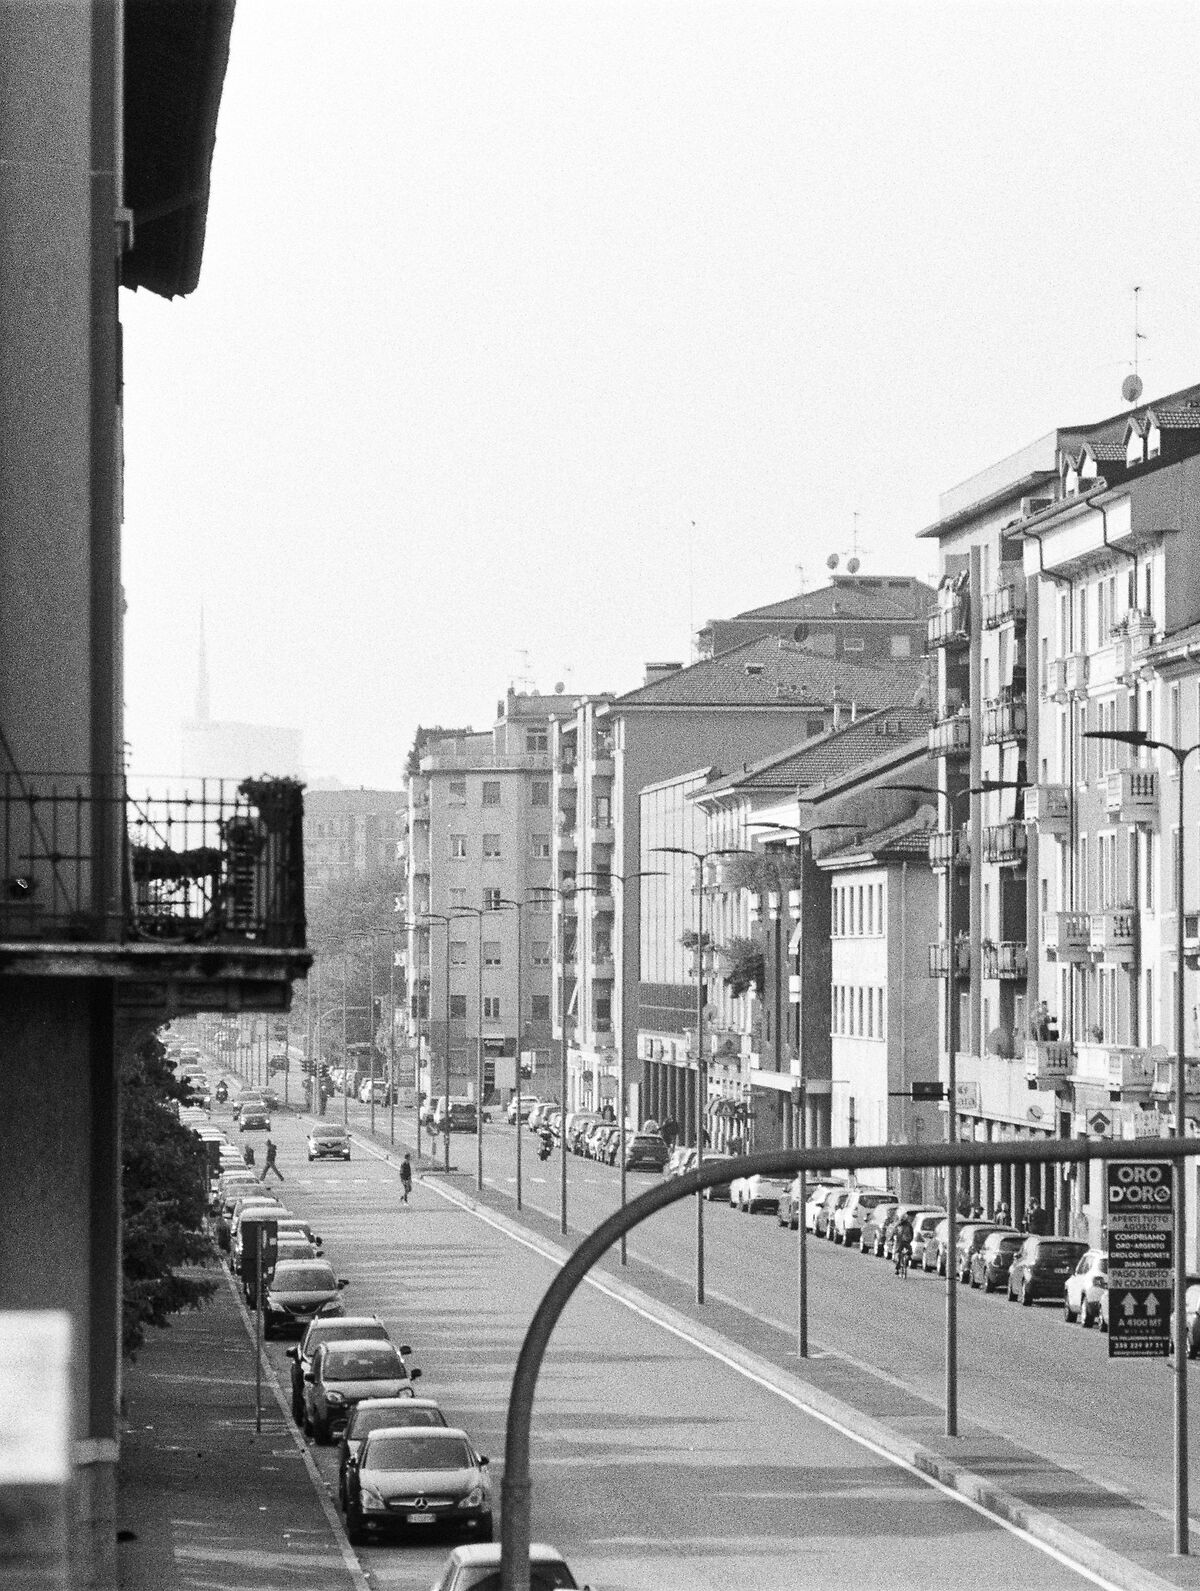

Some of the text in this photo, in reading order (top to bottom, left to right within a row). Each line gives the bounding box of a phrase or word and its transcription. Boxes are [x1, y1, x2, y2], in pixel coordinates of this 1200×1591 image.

[1118, 1167, 1162, 1183] ORO
[1109, 1186, 1171, 1203] D'ORO
[1114, 1233, 1166, 1241] COMPRIAMO
